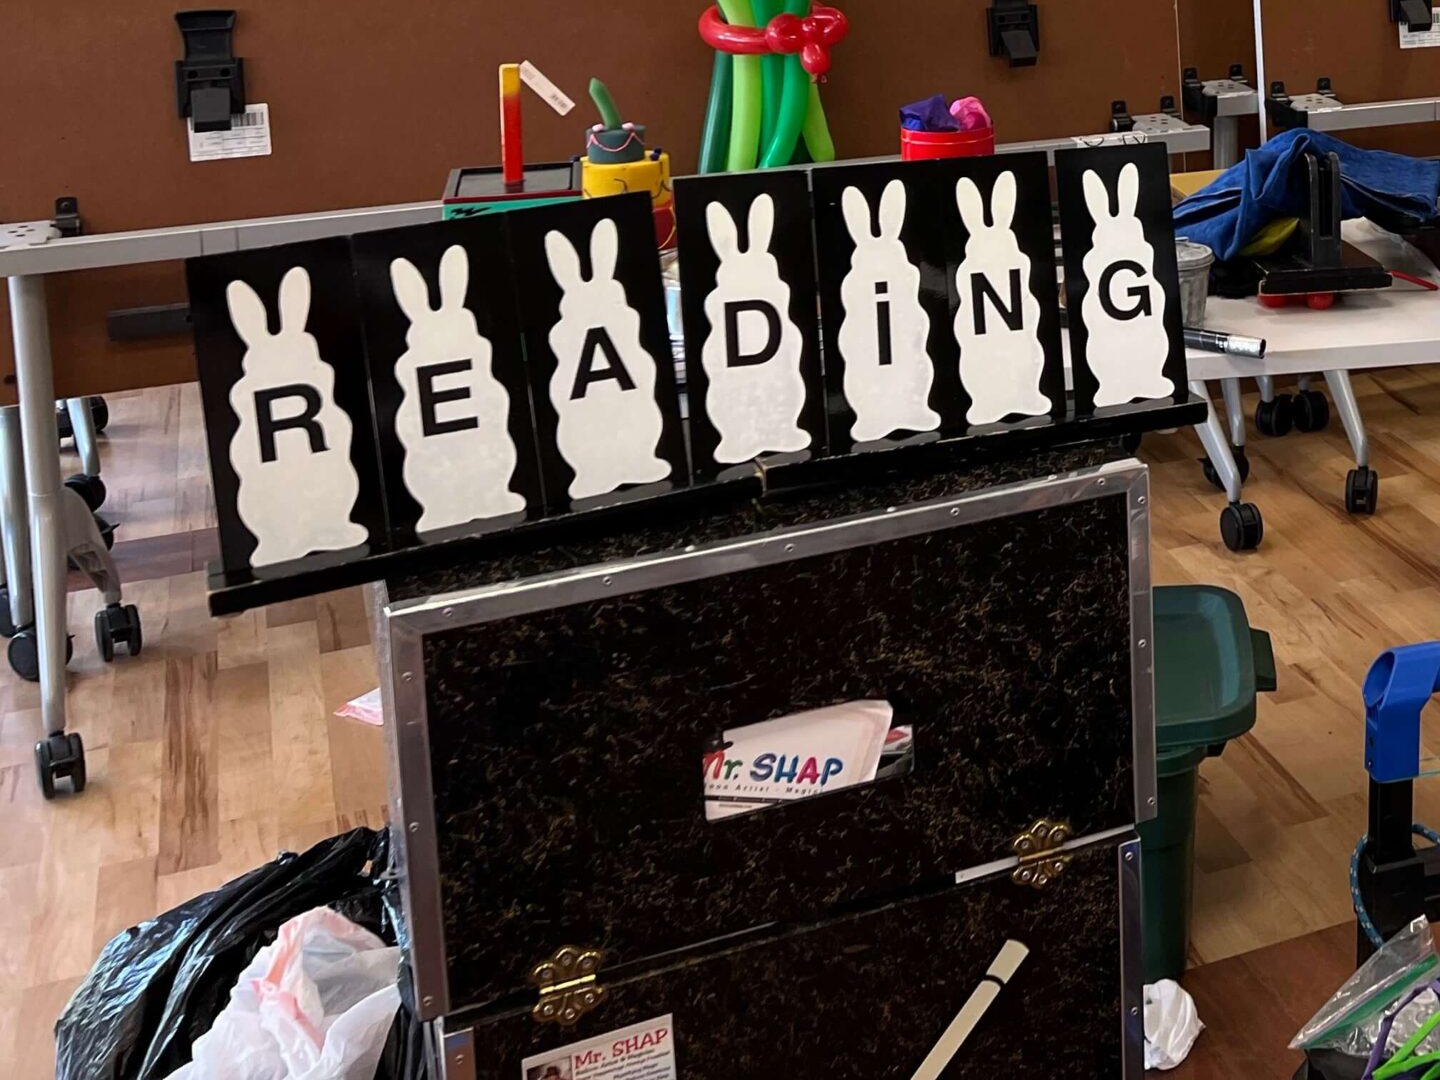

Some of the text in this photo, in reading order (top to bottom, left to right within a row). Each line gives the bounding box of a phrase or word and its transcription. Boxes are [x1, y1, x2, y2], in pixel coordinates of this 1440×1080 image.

[750, 753, 844, 787] SHAP
[574, 1049, 606, 1070] Mr.
[612, 1027, 668, 1058] SHAP
